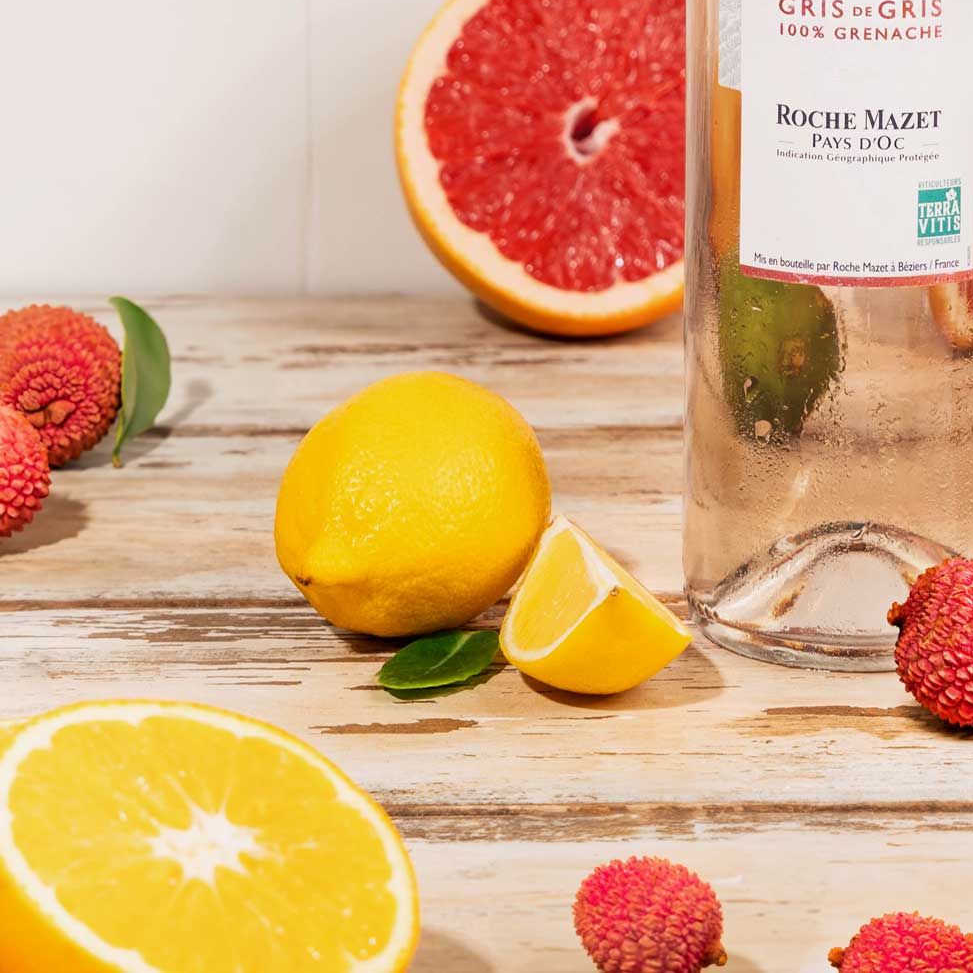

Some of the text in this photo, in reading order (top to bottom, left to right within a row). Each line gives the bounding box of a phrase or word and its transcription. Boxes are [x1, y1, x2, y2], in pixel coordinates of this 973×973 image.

[852, 6, 873, 17] DE
[779, 22, 943, 41] 100% GRENACHE
[776, 103, 942, 130] ROCHE MAZET
[811, 133, 905, 150] PAYS D'OC
[776, 149, 940, 164] Indication Géographique Protégée
[918, 200, 961, 218] TERRA
[918, 215, 961, 234] VITIS
[754, 252, 766, 264] Mis
[768, 256, 778, 266] en
[780, 257, 815, 270] bouteille
[816, 262, 829, 272] par
[833, 261, 860, 272] Roche
[863, 262, 889, 273] Mazet
[890, 262, 896, 272] à
[898, 260, 927, 272] Béziers
[934, 258, 960, 269] France
